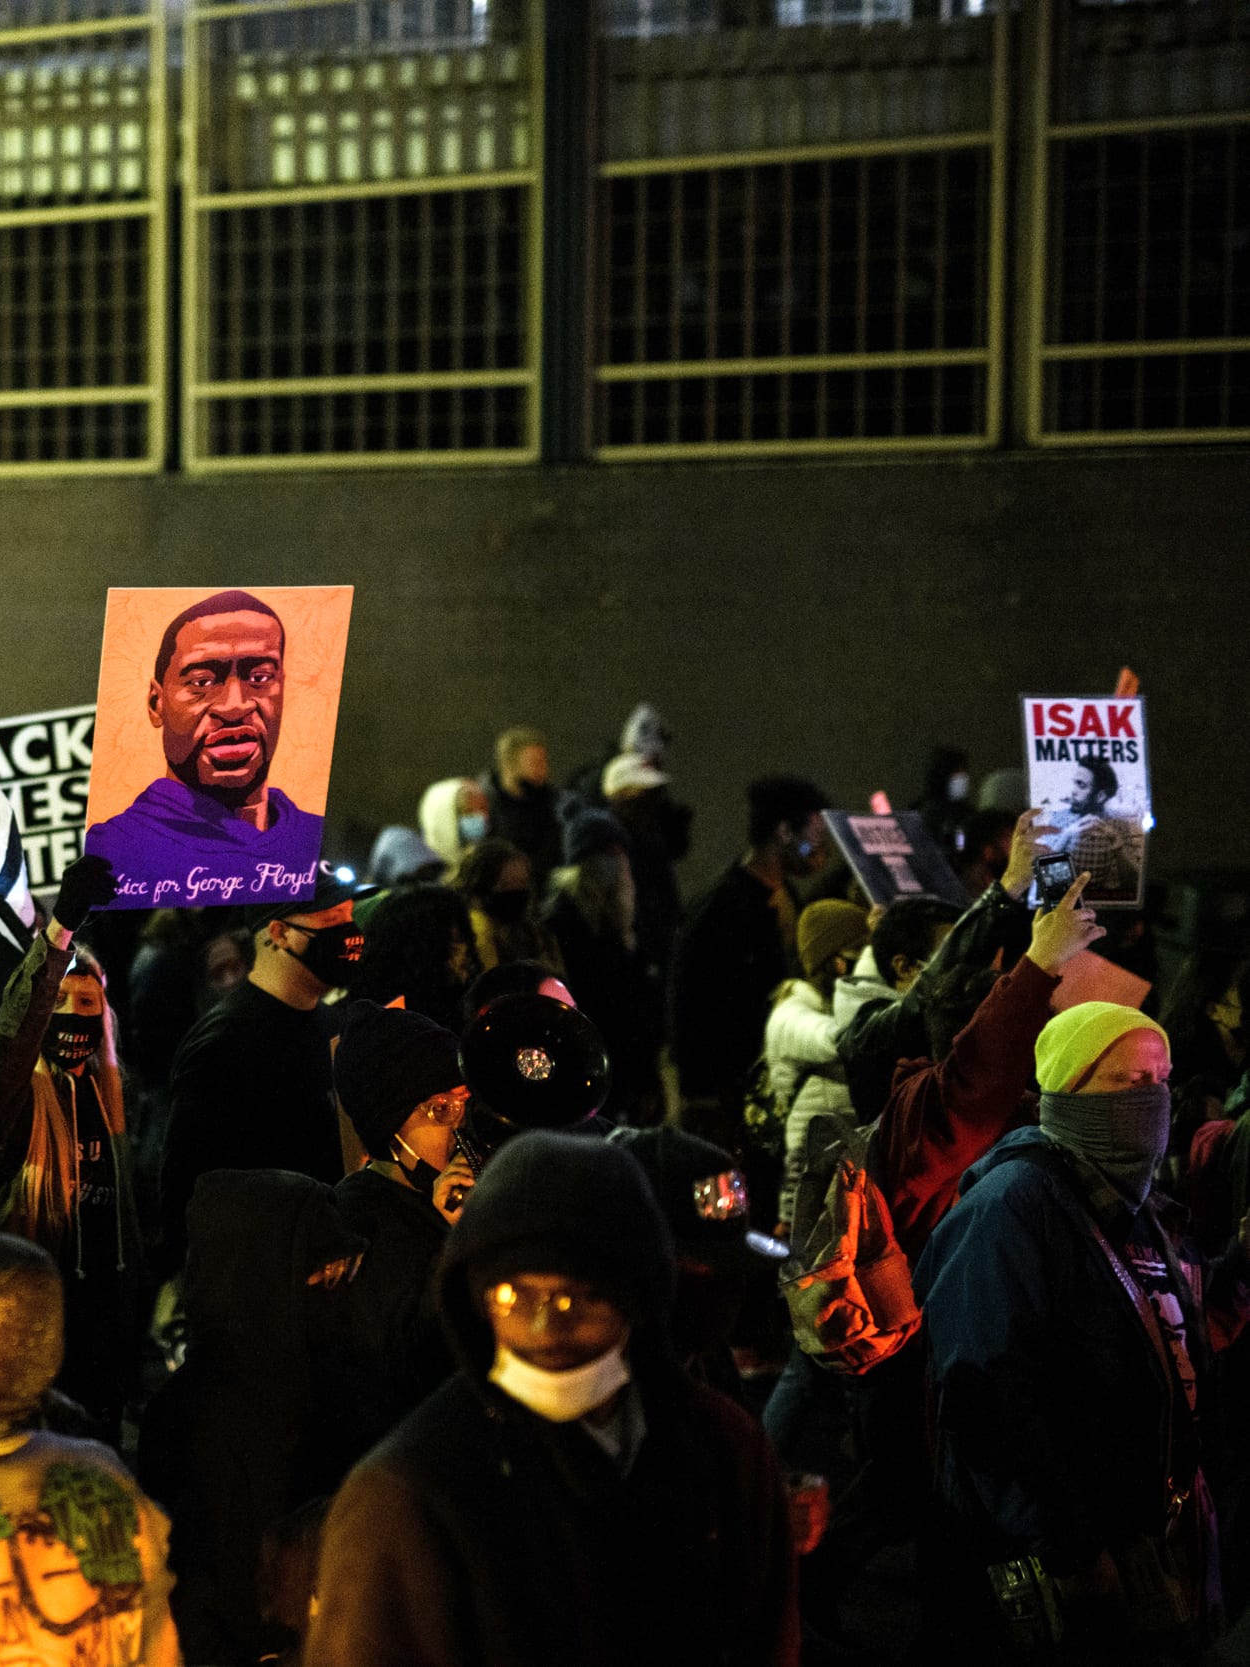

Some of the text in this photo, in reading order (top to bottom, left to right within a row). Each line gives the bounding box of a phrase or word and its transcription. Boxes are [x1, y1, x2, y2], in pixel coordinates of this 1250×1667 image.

[1032, 703, 1137, 738] ISAK
[1034, 739, 1139, 763] MATTERS
[21, 829, 86, 886] TE
[152, 879, 181, 904] for
[186, 866, 245, 901] George
[250, 860, 317, 897] Floyd
[57, 1031, 89, 1043] VISUAL
